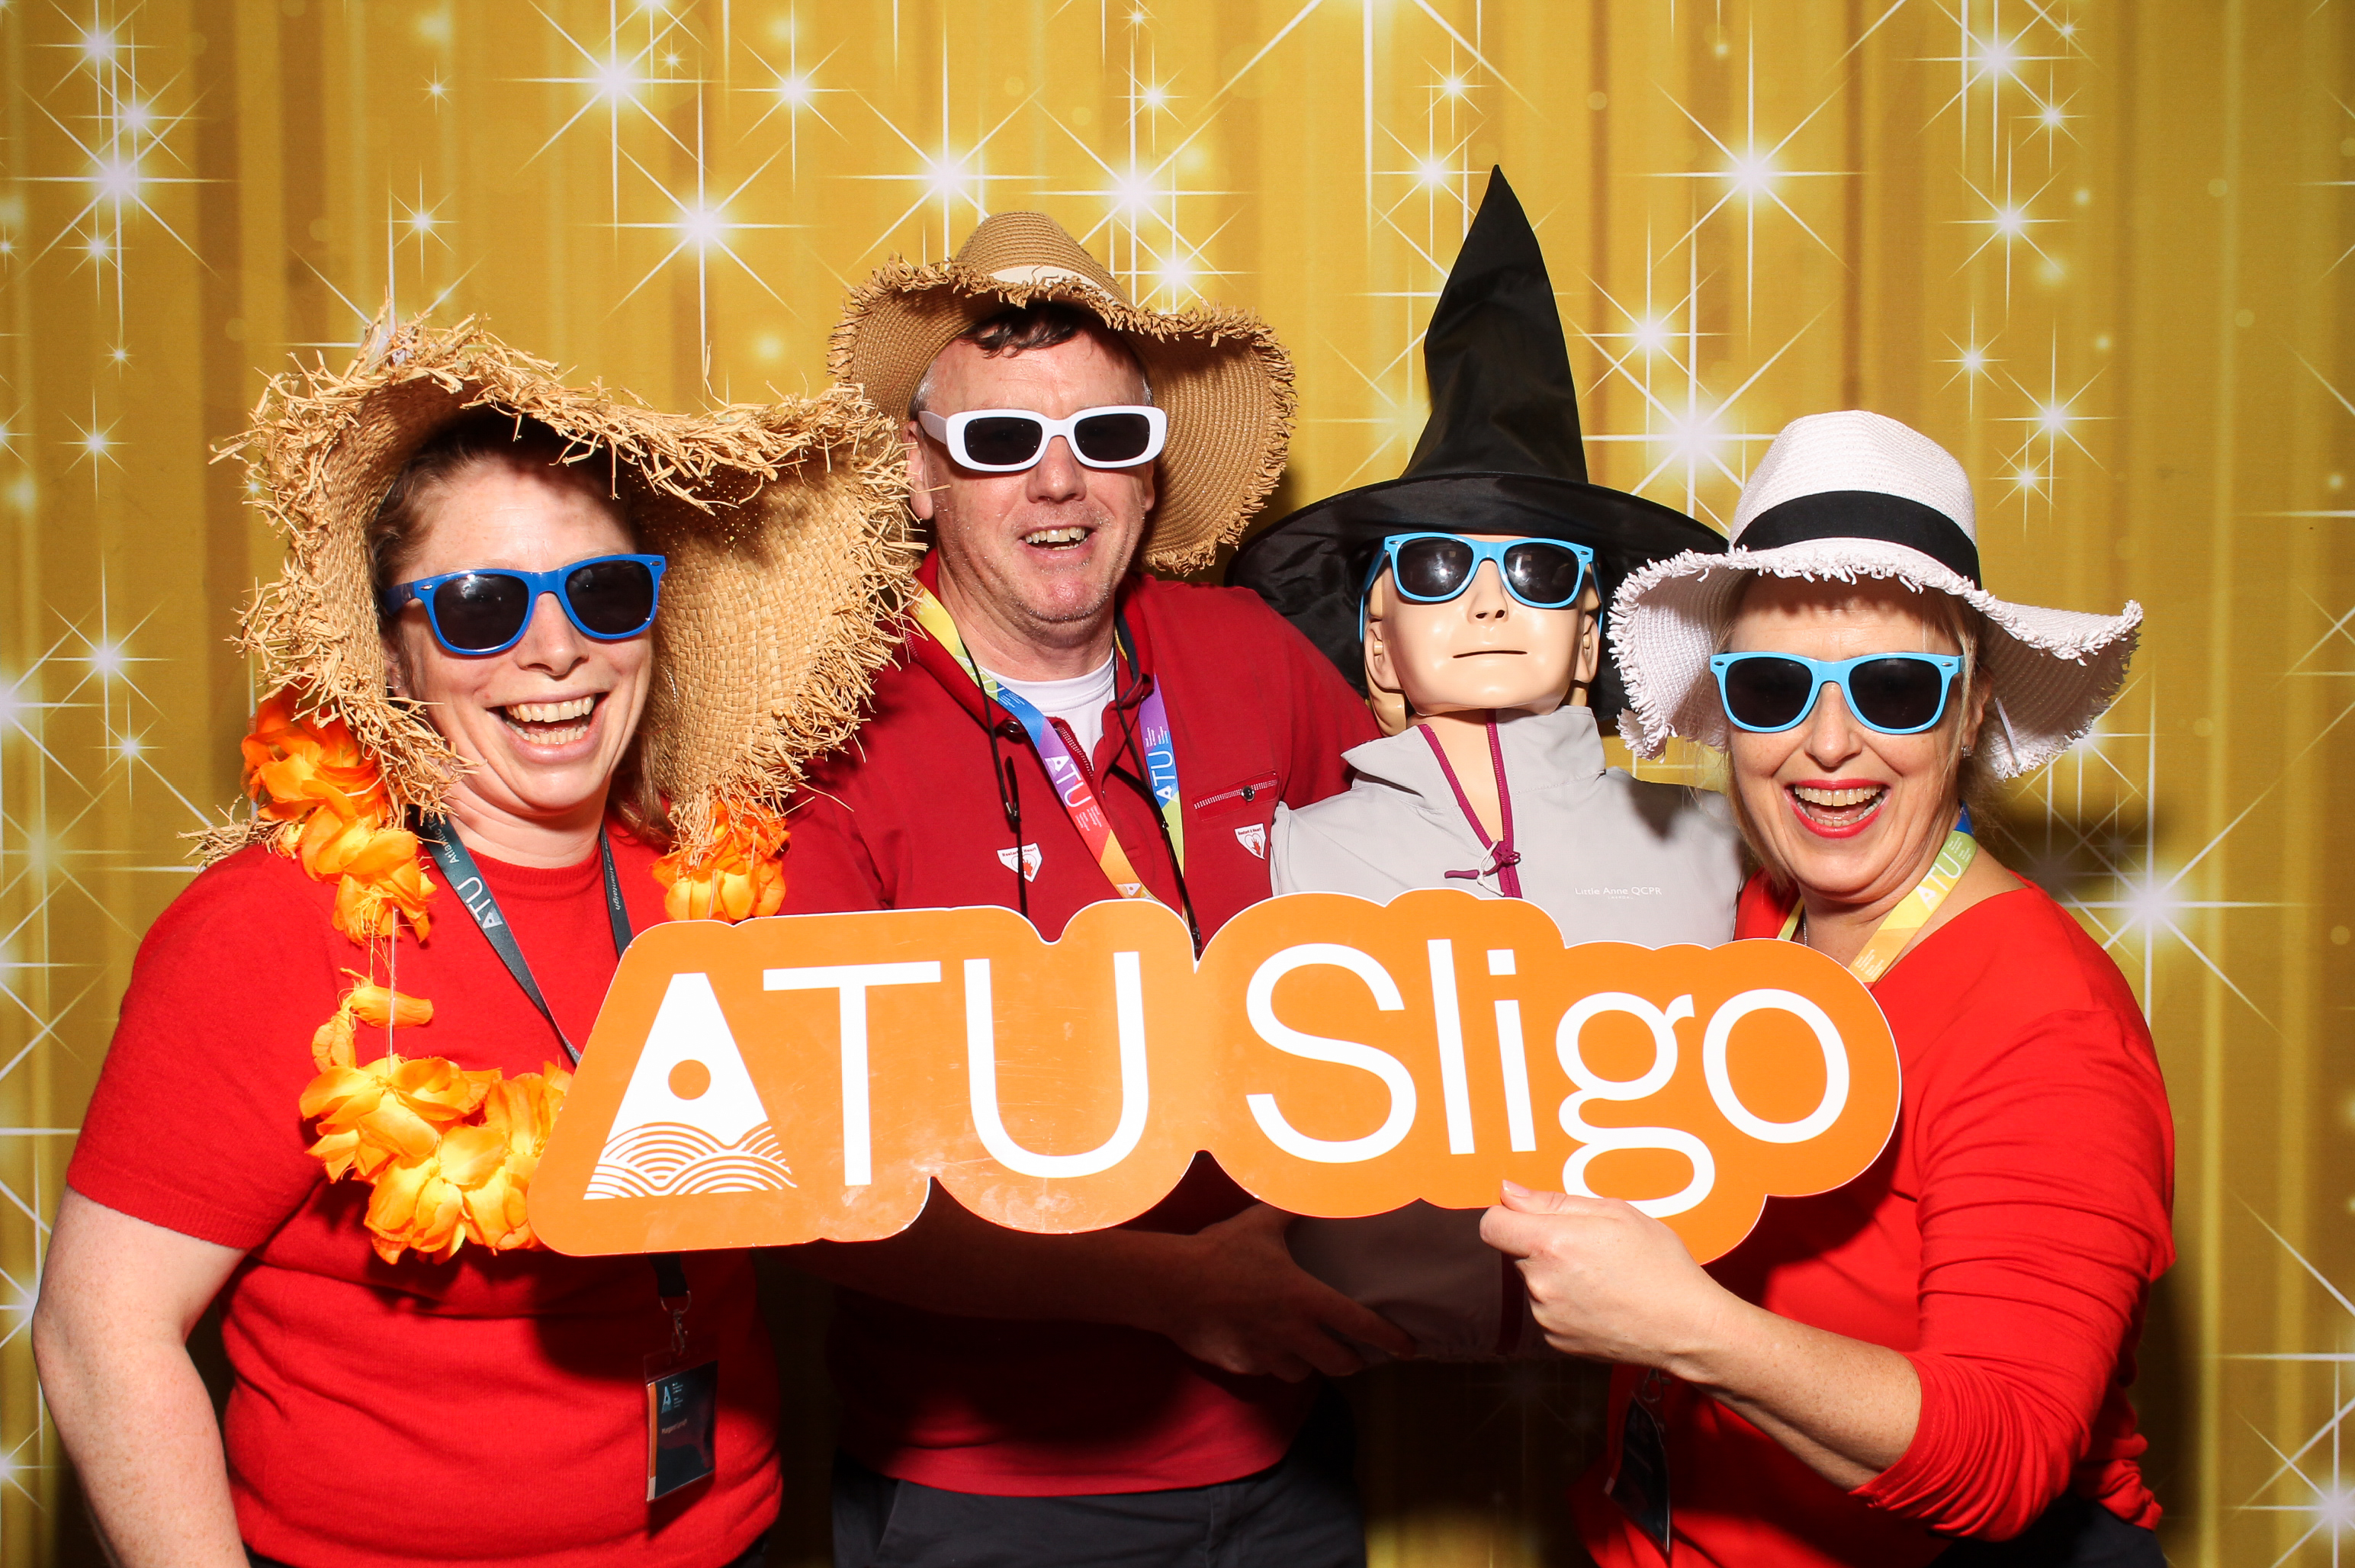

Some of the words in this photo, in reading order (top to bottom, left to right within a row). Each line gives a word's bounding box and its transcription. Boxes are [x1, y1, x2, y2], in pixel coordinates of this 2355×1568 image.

[1044, 755, 1091, 808] ATU
[1148, 750, 1179, 803] ATU
[457, 876, 503, 929] ATU
[1574, 886, 1600, 895] Little
[1602, 886, 1629, 895] Anne
[1631, 885, 1663, 896] QCPR
[1915, 851, 1961, 911] ATU
[585, 951, 1149, 1198] ATU
[1246, 940, 1849, 1219] Sligo
